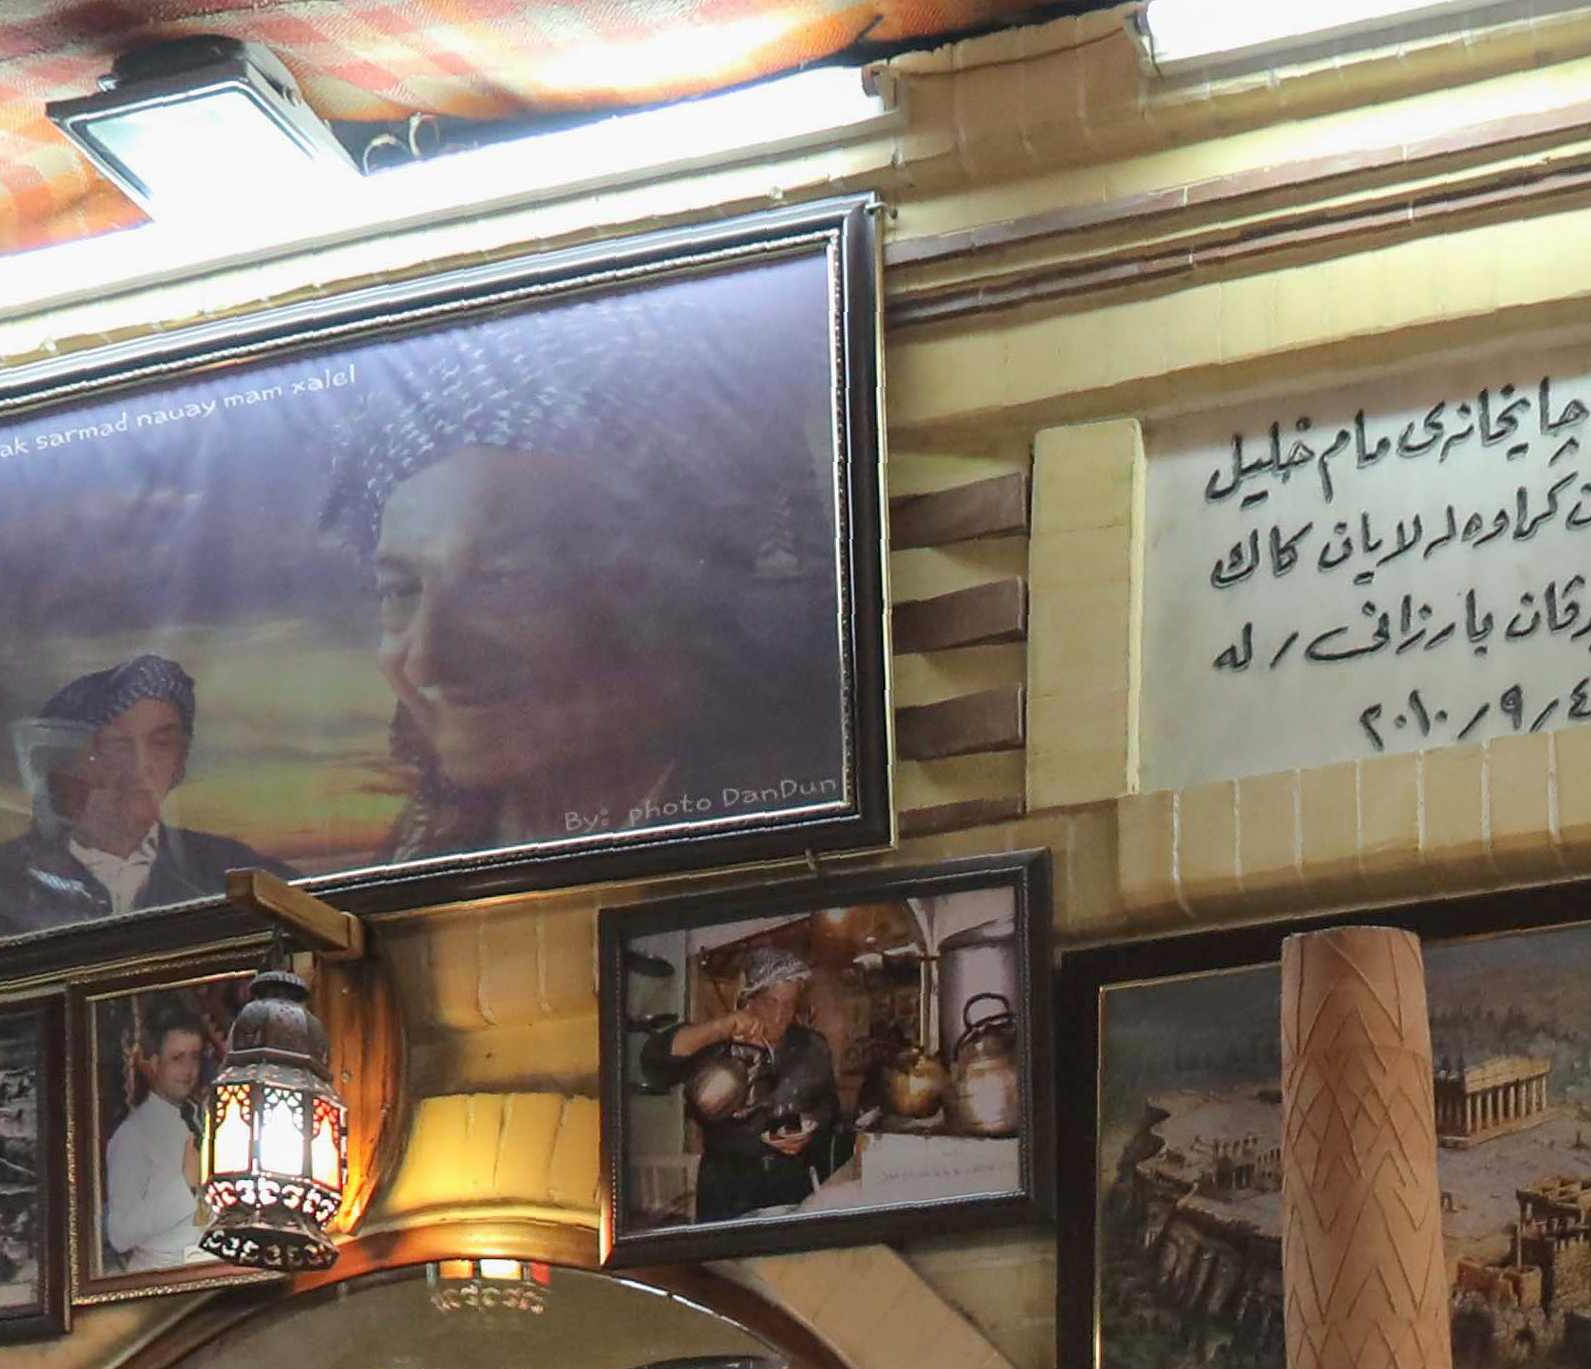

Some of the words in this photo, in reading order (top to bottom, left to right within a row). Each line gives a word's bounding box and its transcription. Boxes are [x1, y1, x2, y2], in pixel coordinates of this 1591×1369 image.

[35, 413, 129, 448] sarmad
[224, 386, 283, 409] mam
[291, 364, 356, 396] xalel
[1317, 409, 1392, 504] مام
[629, 794, 711, 824] photo
[723, 778, 836, 807] DanDun
